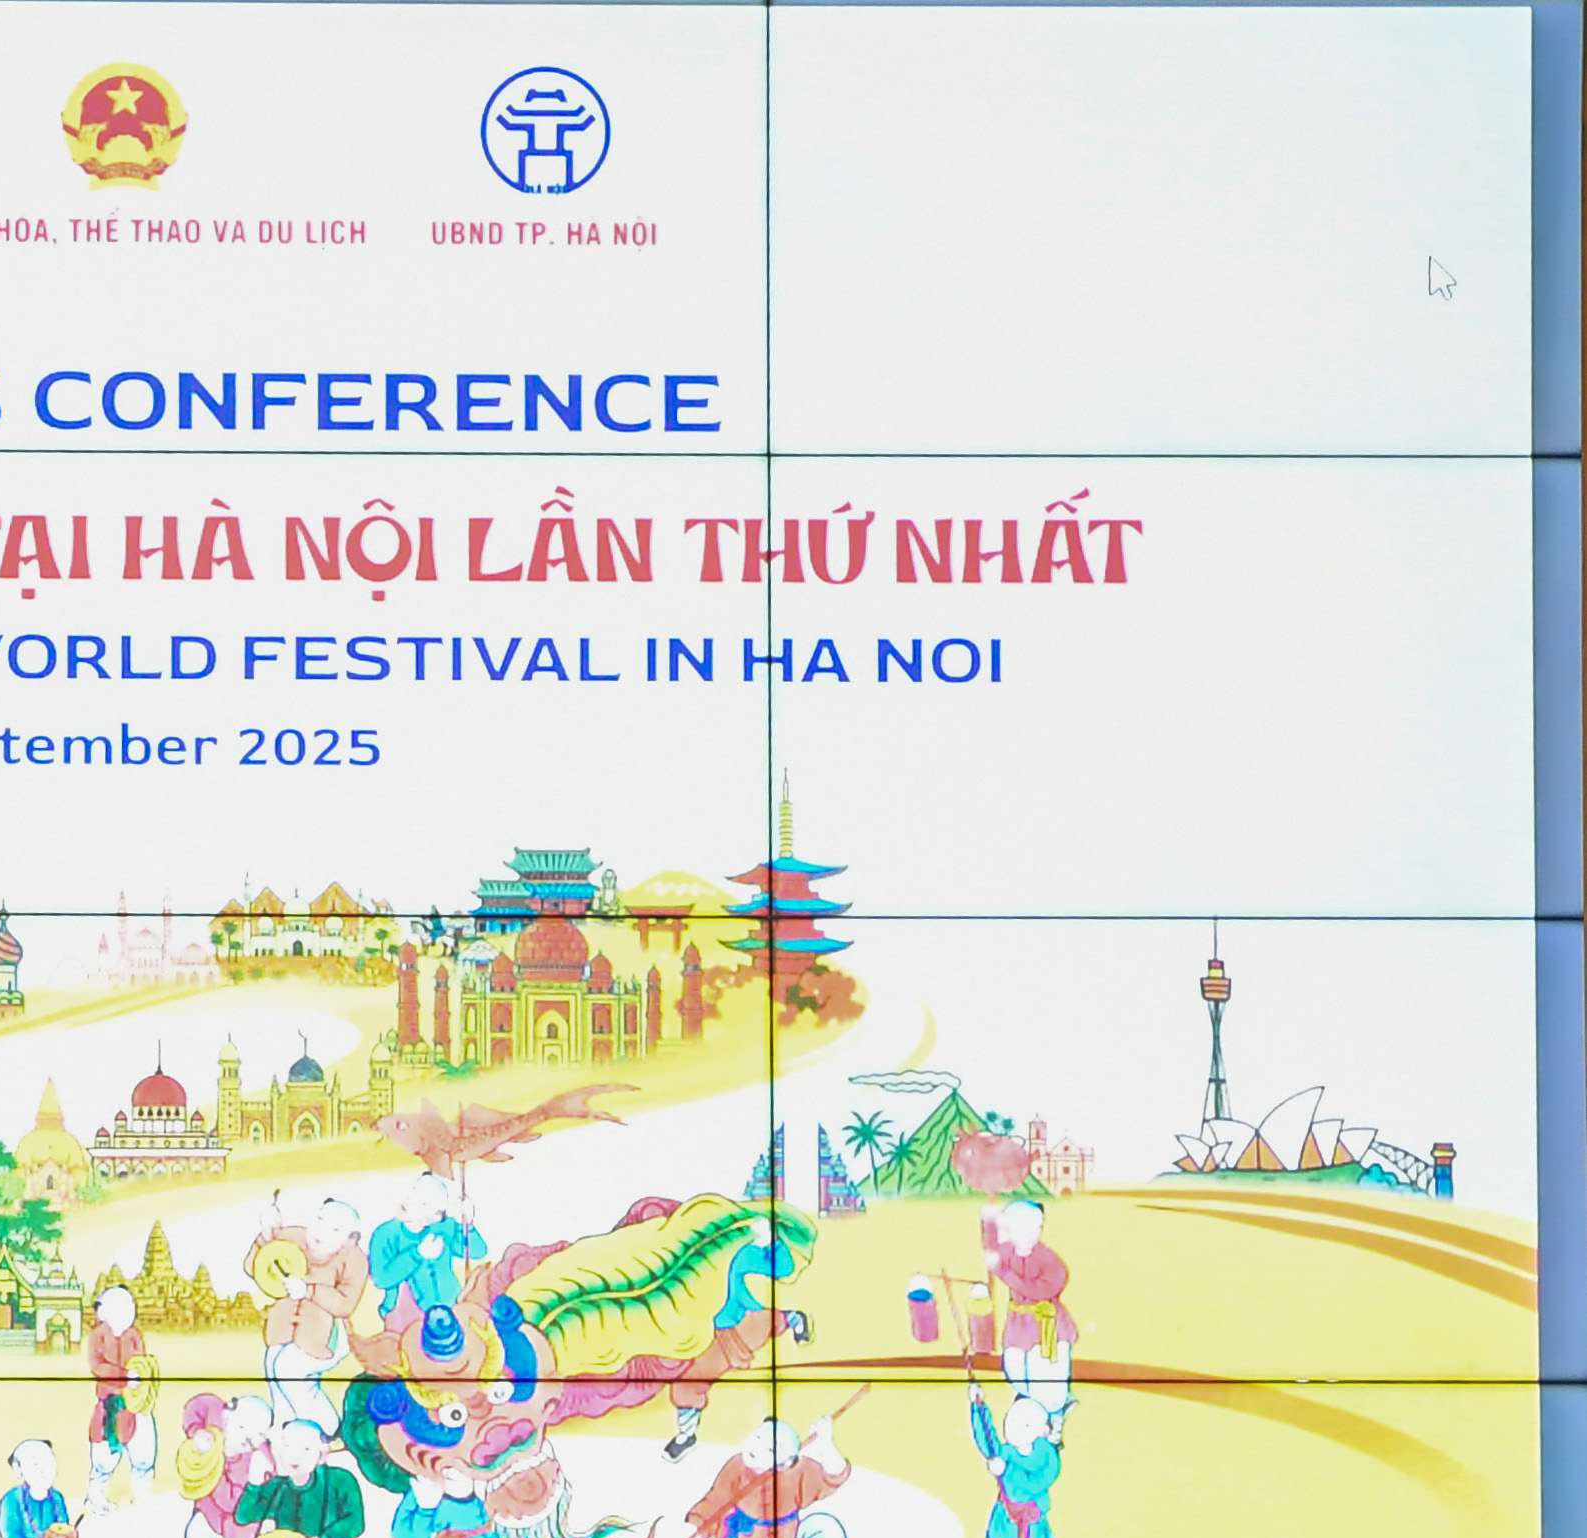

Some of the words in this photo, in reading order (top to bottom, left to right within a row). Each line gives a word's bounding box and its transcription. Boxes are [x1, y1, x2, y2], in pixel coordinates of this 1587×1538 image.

[131, 219, 201, 243] THAO
[259, 220, 293, 244] DU
[306, 220, 366, 250] LỊCH
[432, 222, 503, 245] UBND
[515, 222, 554, 245] TP.
[35, 371, 721, 432] CONFERENCE
[123, 498, 254, 580] HÀ
[286, 499, 437, 601] NỘI
[469, 486, 652, 582] LẦN
[685, 502, 875, 584] THỨ
[896, 488, 1142, 583] NHẤT
[244, 636, 620, 681] FESTIVAL
[647, 638, 713, 681] IN
[743, 638, 850, 682] HA
[878, 638, 1001, 683] NOI
[239, 729, 380, 766] 2025
